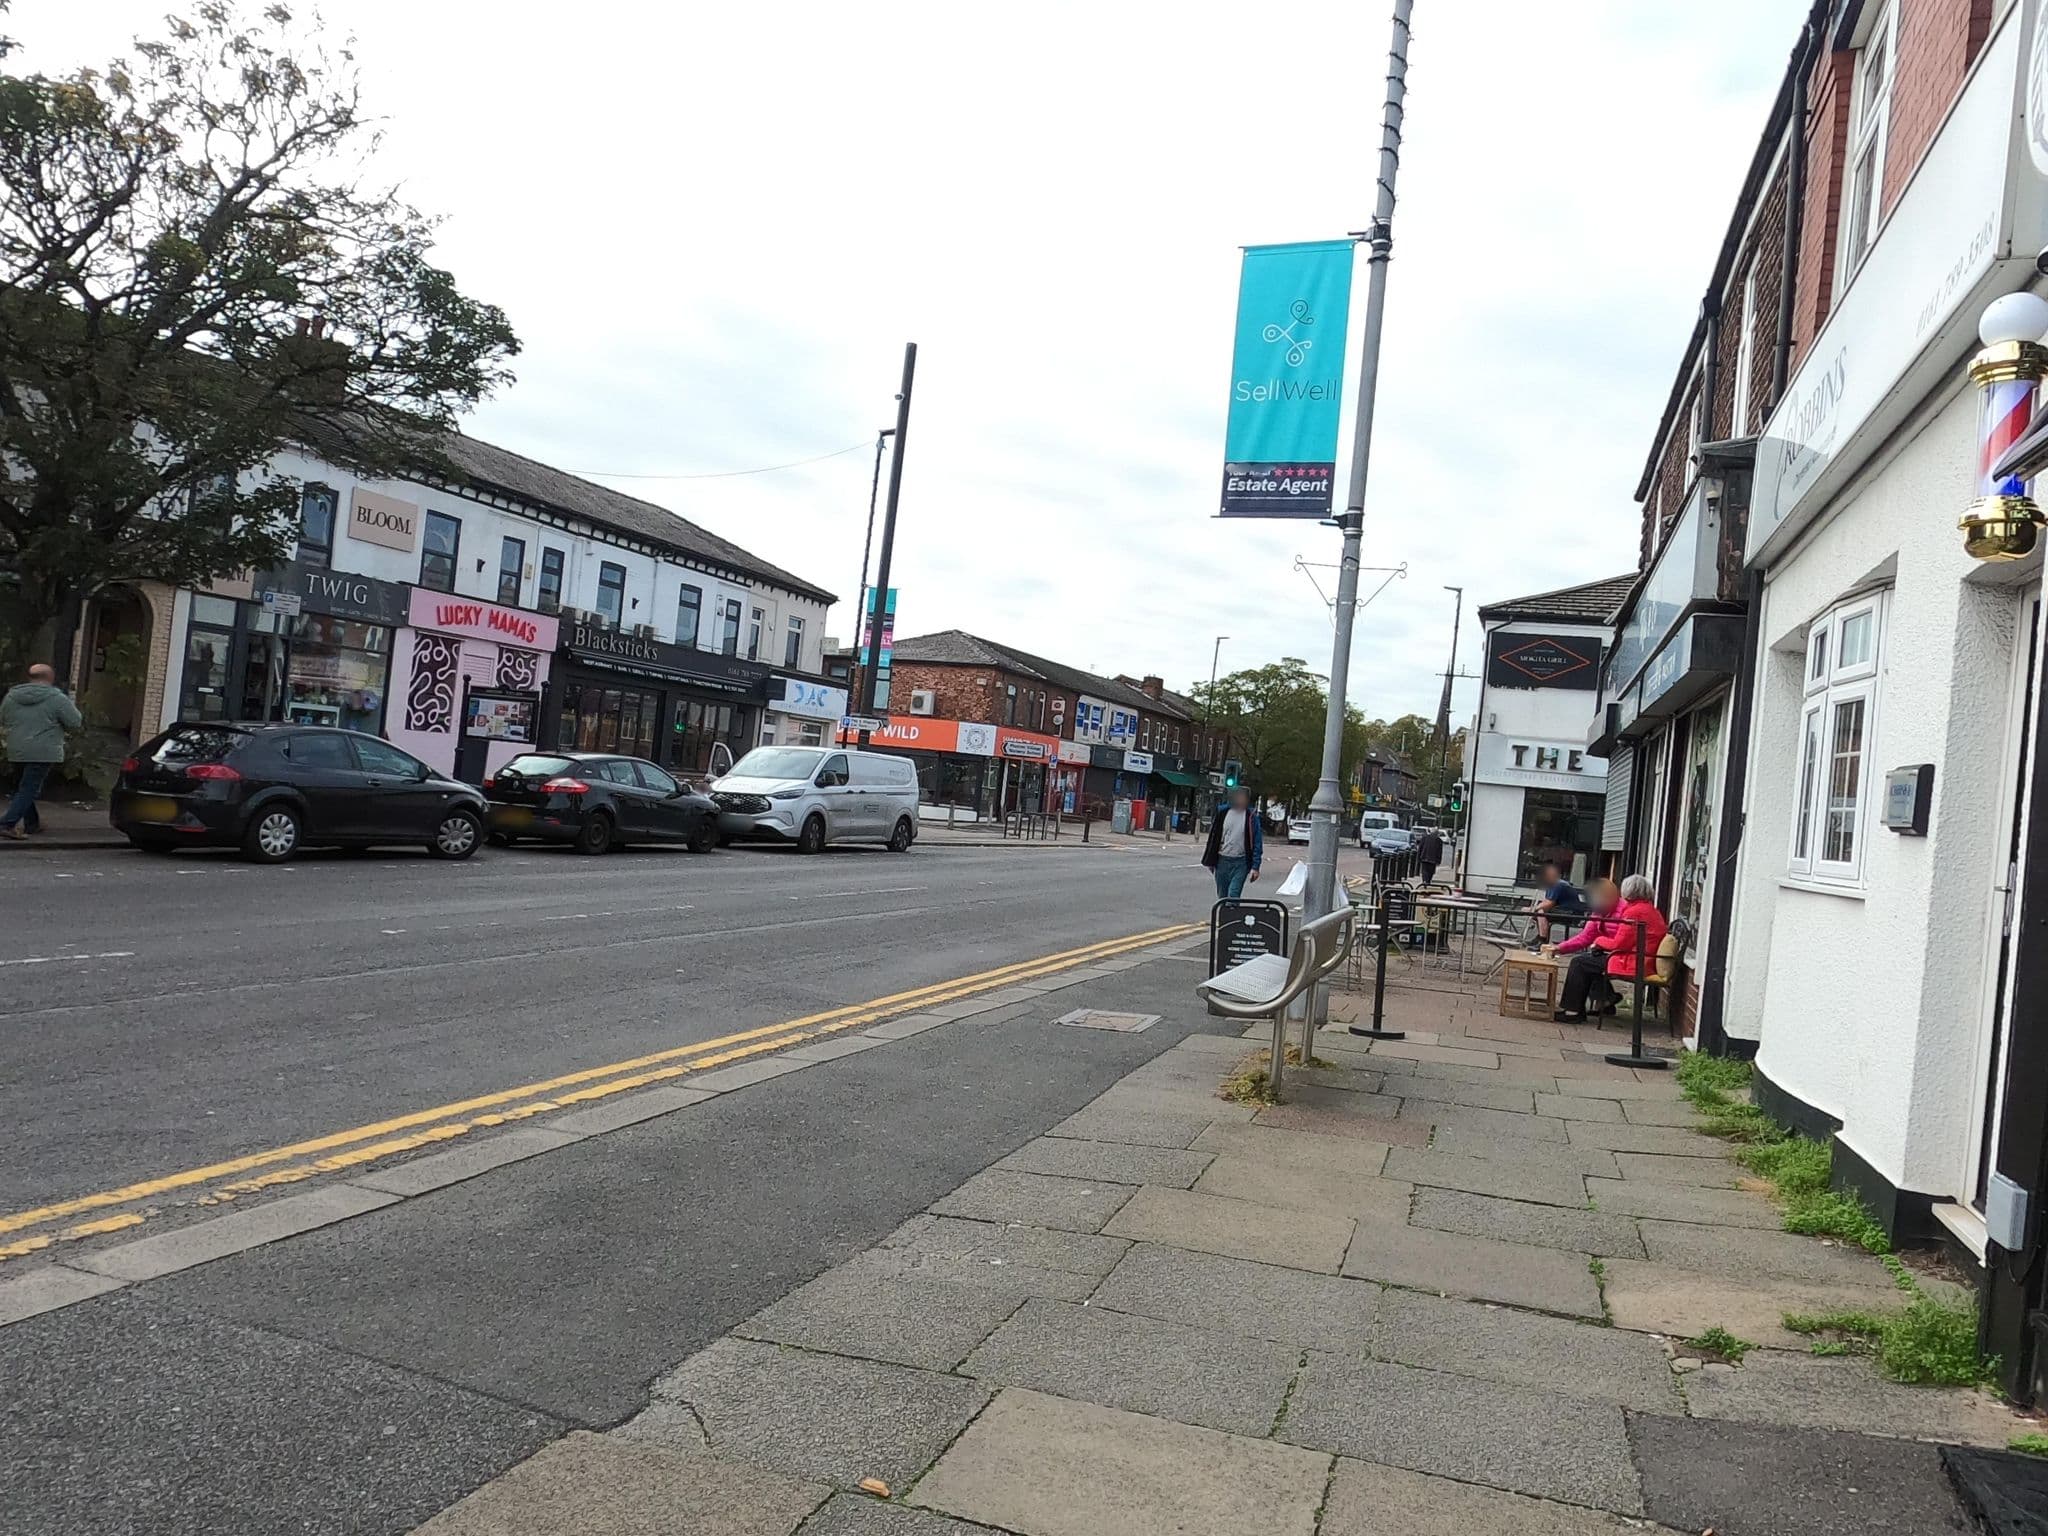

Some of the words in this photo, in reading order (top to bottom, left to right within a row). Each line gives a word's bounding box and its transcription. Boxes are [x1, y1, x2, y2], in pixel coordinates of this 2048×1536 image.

[1235, 379, 1337, 402] SellWell
[1227, 478, 1277, 492] Estate
[1279, 478, 1328, 495] Agent
[357, 506, 412, 535] BLOOM
[306, 573, 368, 604] TWIG
[436, 605, 482, 626] LUCKY
[488, 609, 537, 643] MAMA'S
[575, 627, 658, 661] Blacksticks
[883, 724, 919, 740] WILD
[1511, 745, 1583, 771] THE
